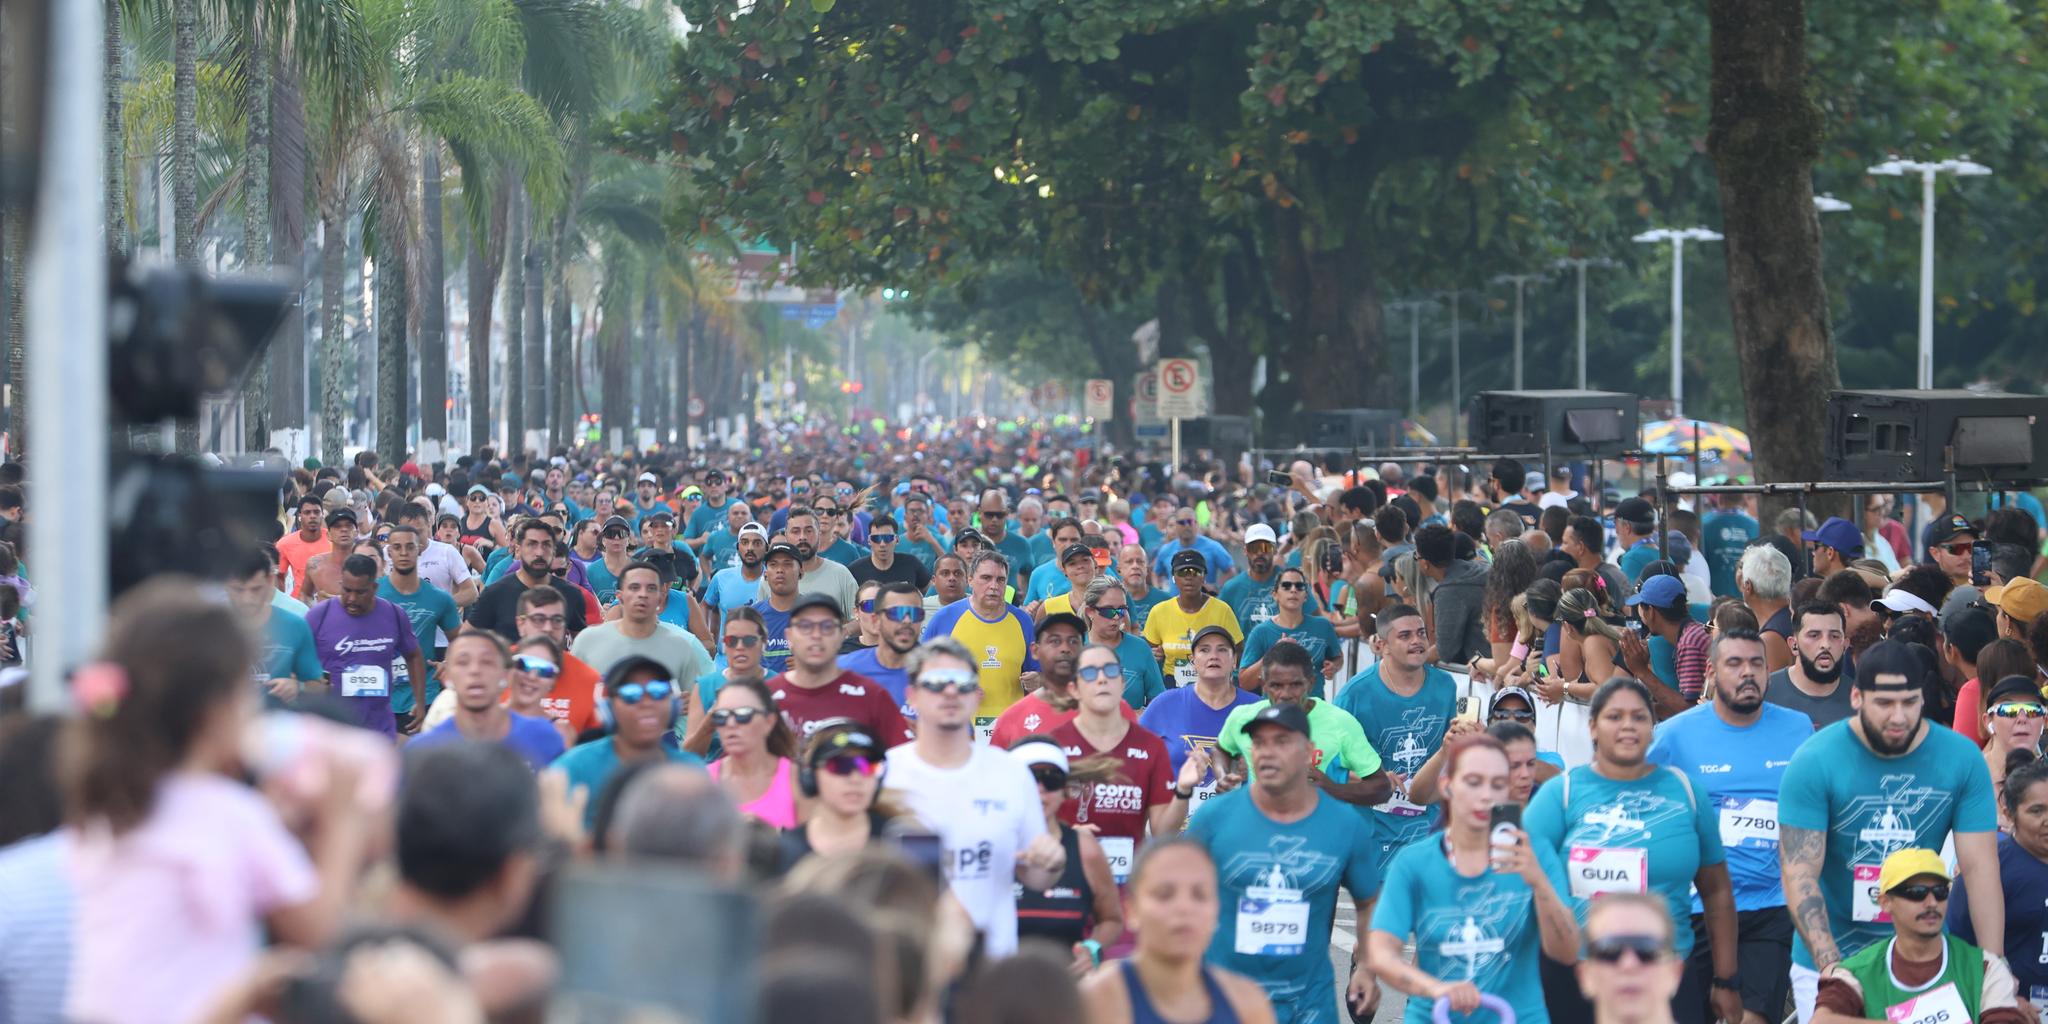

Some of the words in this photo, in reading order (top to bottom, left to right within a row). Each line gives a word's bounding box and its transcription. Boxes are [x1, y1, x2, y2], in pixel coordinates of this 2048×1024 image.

[394, 663, 407, 671] 70
[350, 676, 377, 684] 8109
[1127, 748, 1148, 759] FILA
[1094, 783, 1143, 799] corre
[1731, 815, 1776, 831] 7780
[1109, 856, 1127, 867] 76
[1582, 868, 1629, 881] GUIA
[1251, 921, 1299, 935] 9879
